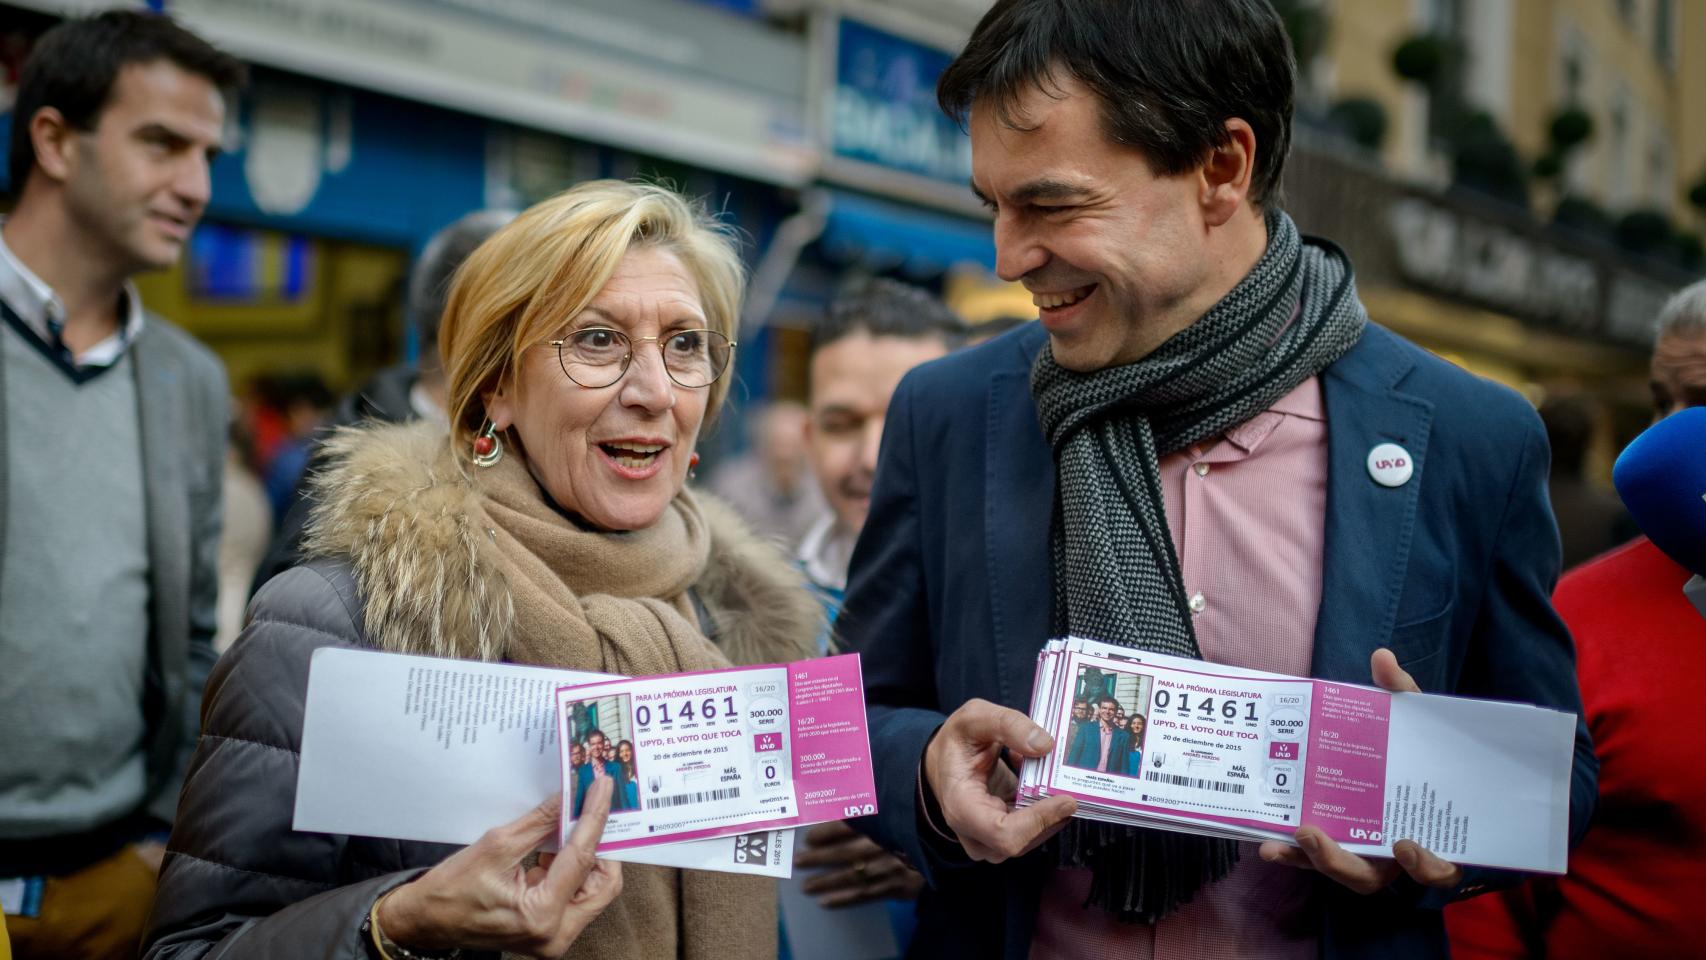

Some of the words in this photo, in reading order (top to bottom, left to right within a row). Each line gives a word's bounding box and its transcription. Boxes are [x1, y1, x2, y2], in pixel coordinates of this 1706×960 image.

[795, 672, 807, 680] 1461
[663, 688, 693, 699] PRÓXIMA
[694, 684, 737, 695] LEGISLATURA
[755, 684, 775, 693] 16/20
[1186, 683, 1217, 694] PRÓXIMA
[1218, 687, 1262, 700] LEGISLATURA
[1324, 686, 1339, 694] 1461
[1279, 695, 1299, 705] 16/20
[750, 708, 782, 718] 300.000
[1270, 716, 1303, 729] 300.000
[1153, 719, 1178, 729] UPYD,
[1192, 725, 1214, 733] VOTO
[1216, 728, 1234, 737] QUE
[1236, 731, 1258, 740] TOCA
[1277, 727, 1294, 735] SERIE
[1320, 729, 1338, 738] 16/20
[640, 738, 664, 748] UPYD,
[677, 734, 699, 743] VOTO
[701, 732, 717, 741] QUE
[719, 729, 741, 738] TOCA
[1181, 737, 1214, 747] diciembre
[672, 748, 702, 758] diciembre
[713, 745, 728, 753] 2015
[800, 752, 825, 761] 300.000
[723, 765, 736, 774] MÁS
[764, 765, 775, 779] 0
[1232, 764, 1246, 772] MÁS
[1316, 765, 1342, 776] 300.000
[720, 772, 741, 782] ESPAÑA
[1226, 769, 1249, 780] ESPAÑA
[1275, 773, 1287, 786] 0
[804, 789, 835, 799] 26092007
[1272, 787, 1290, 795] EUROS
[1148, 795, 1181, 806] 26092007
[1313, 802, 1345, 813] 26092007
